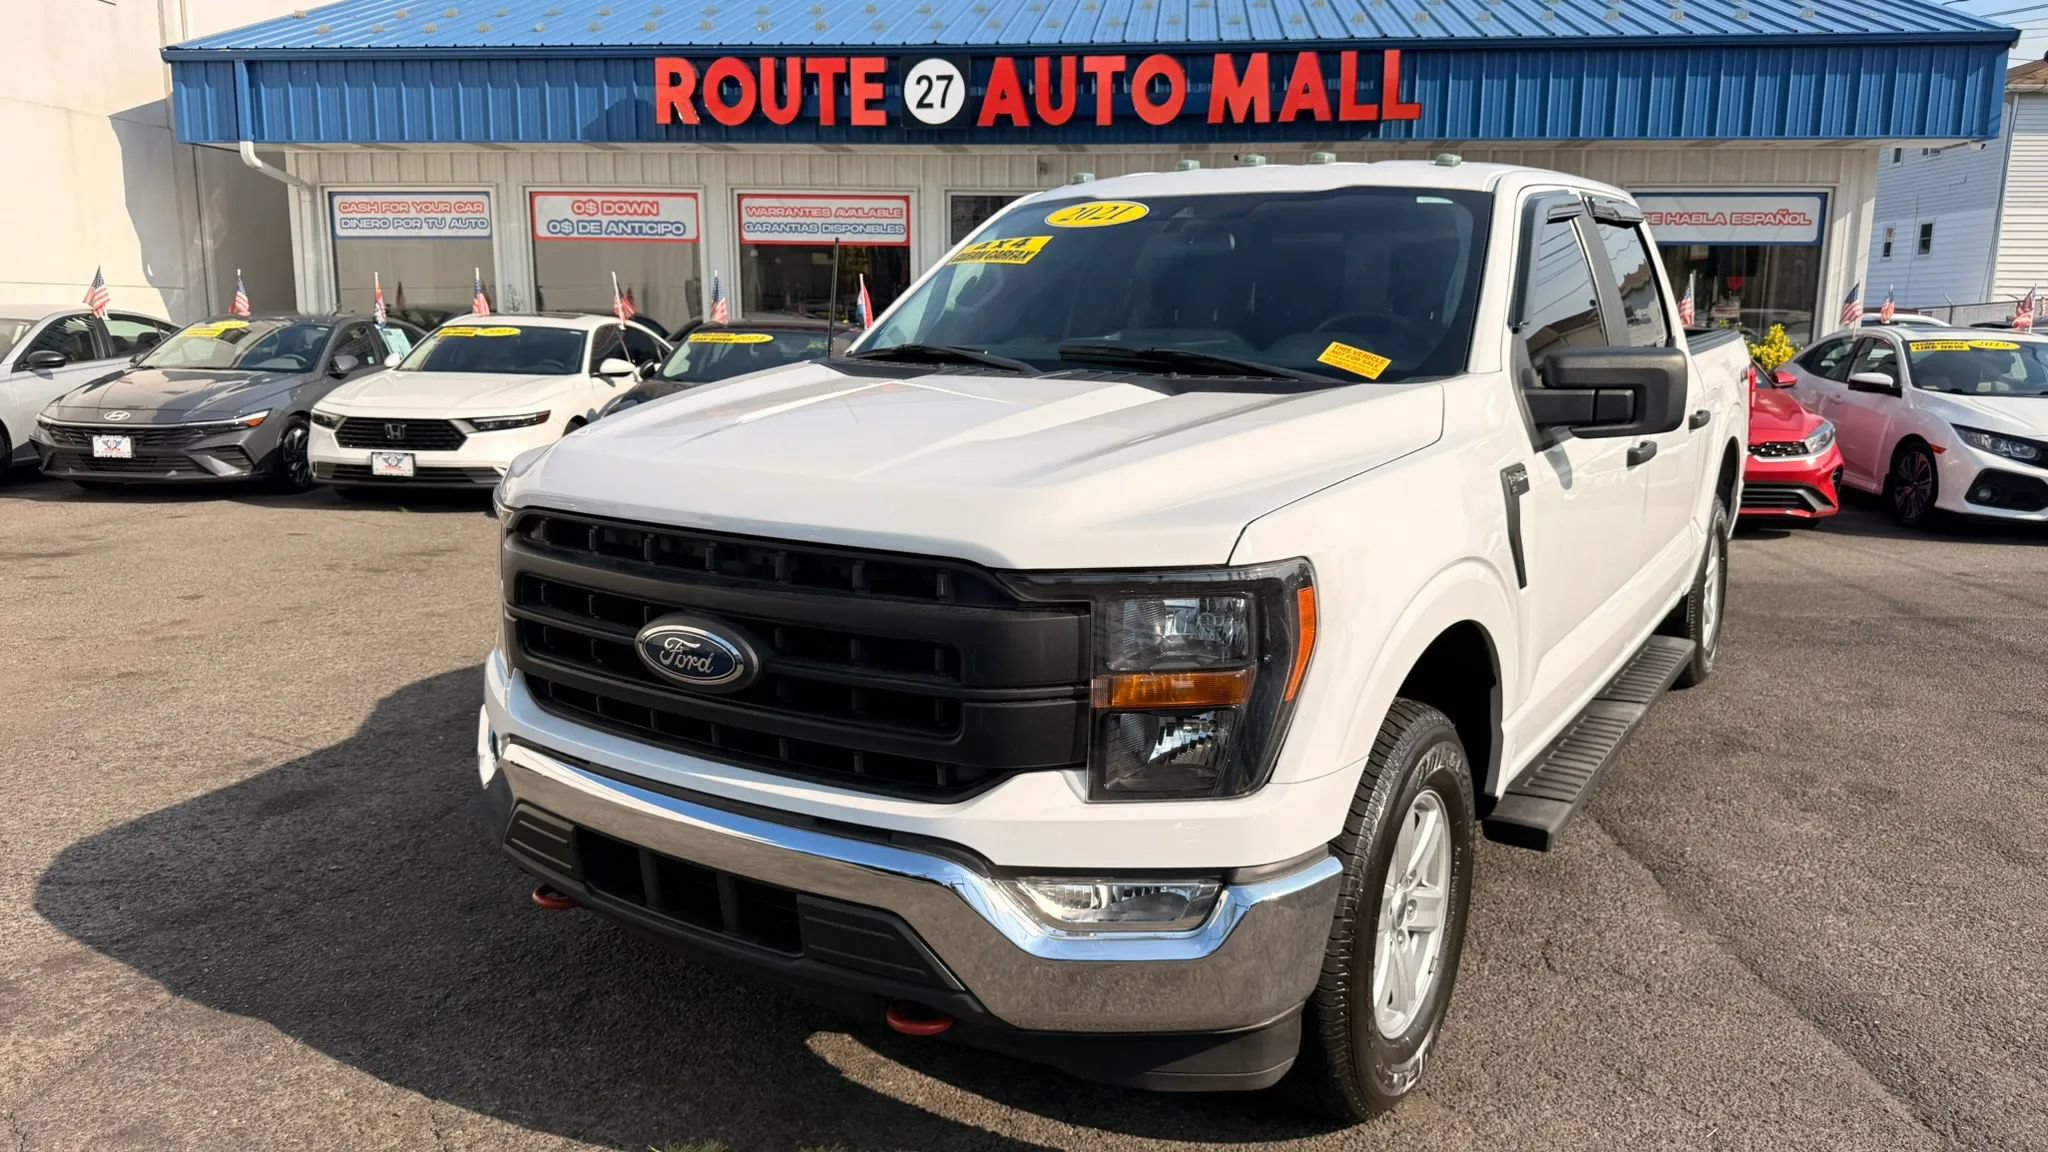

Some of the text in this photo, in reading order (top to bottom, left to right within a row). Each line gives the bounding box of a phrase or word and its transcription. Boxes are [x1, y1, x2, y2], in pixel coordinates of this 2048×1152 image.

[654, 49, 1422, 127] ROUTE 27 AUTO MALL
[339, 201, 485, 214] CASH FOR YOUR CAR
[601, 201, 660, 216] DOWN
[745, 206, 904, 219] WARRANTIES AVAILABLE
[1058, 206, 1135, 222] 2021
[340, 217, 489, 230] DINERO POR TU AUTO
[1664, 211, 1727, 226] HABLA
[1729, 208, 1812, 227] ESPAÑOL
[577, 220, 602, 235] DE
[605, 220, 686, 236] ANTICIPO
[744, 222, 905, 235] GARANTIAS DISPONIBLES
[660, 637, 714, 673] Ford
